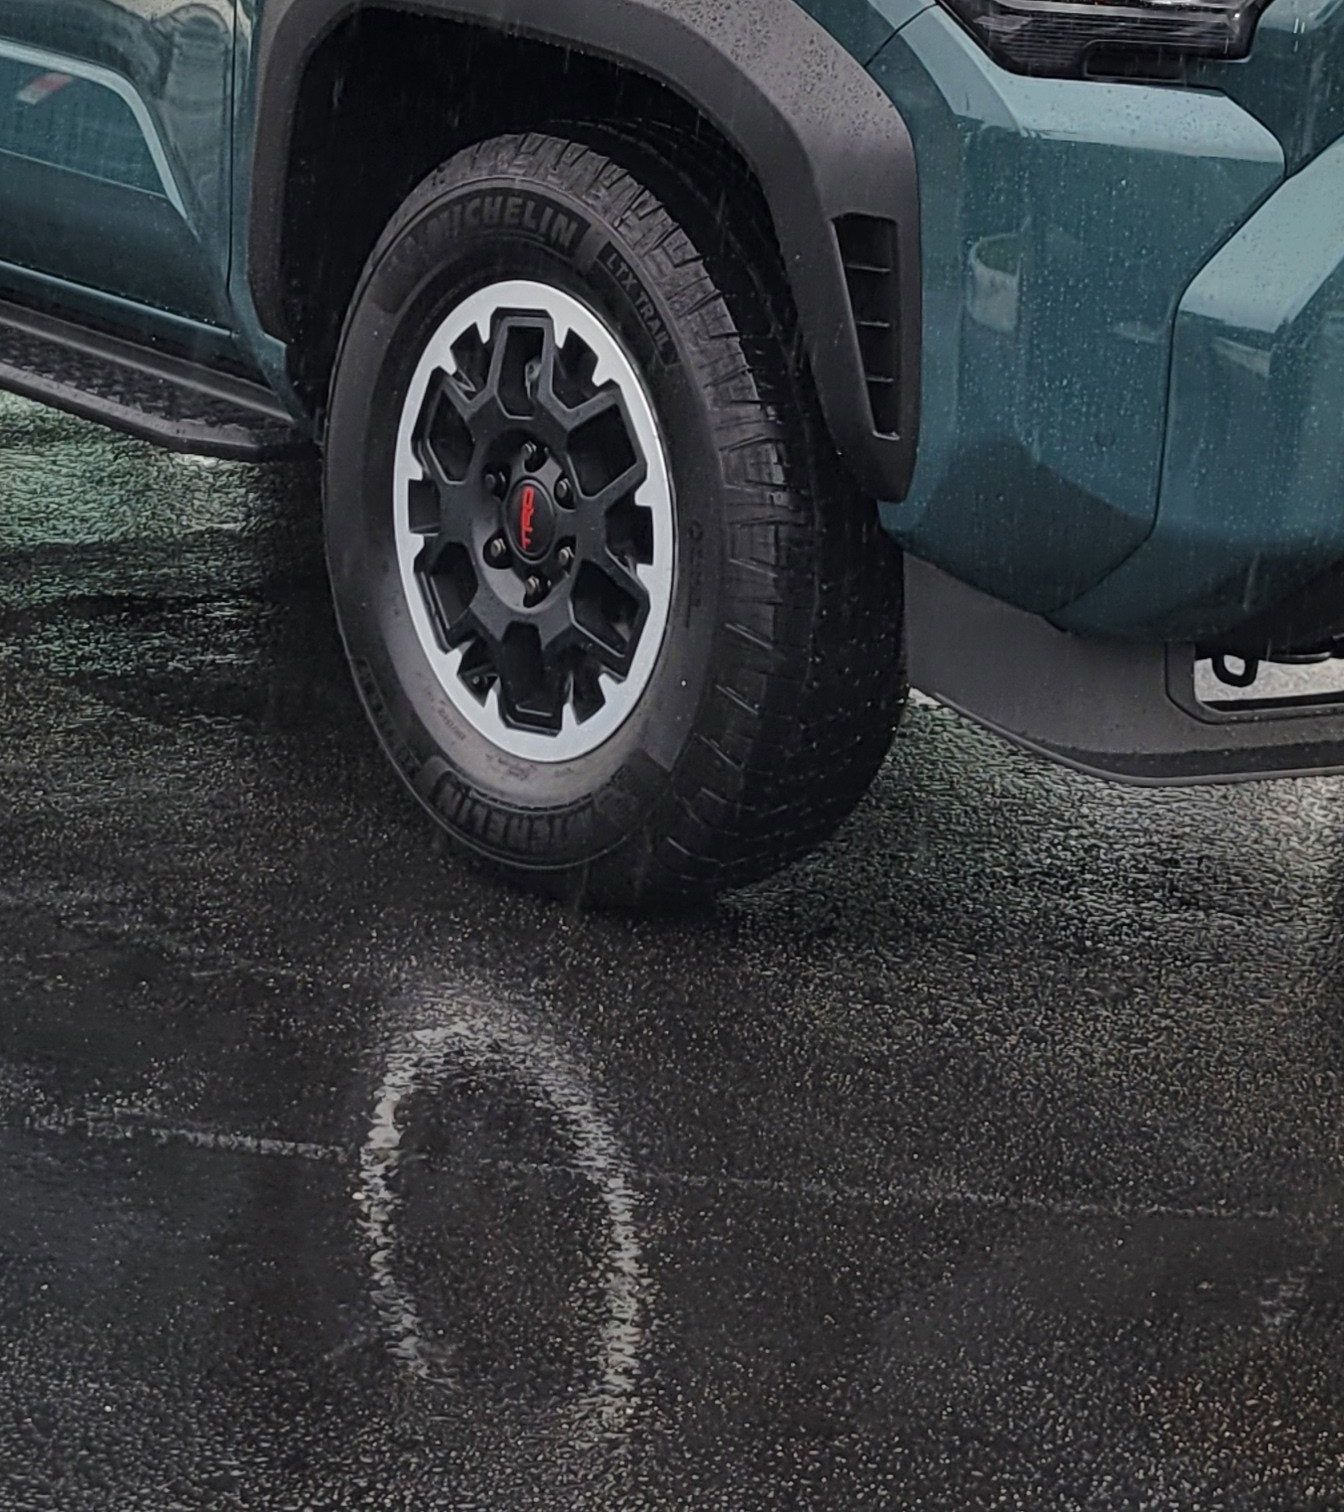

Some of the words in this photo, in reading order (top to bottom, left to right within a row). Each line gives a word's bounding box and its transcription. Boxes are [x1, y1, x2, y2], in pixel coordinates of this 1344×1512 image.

[425, 193, 580, 248] MICHELIN
[605, 252, 636, 290] LTX
[633, 290, 671, 352] TRAIL
